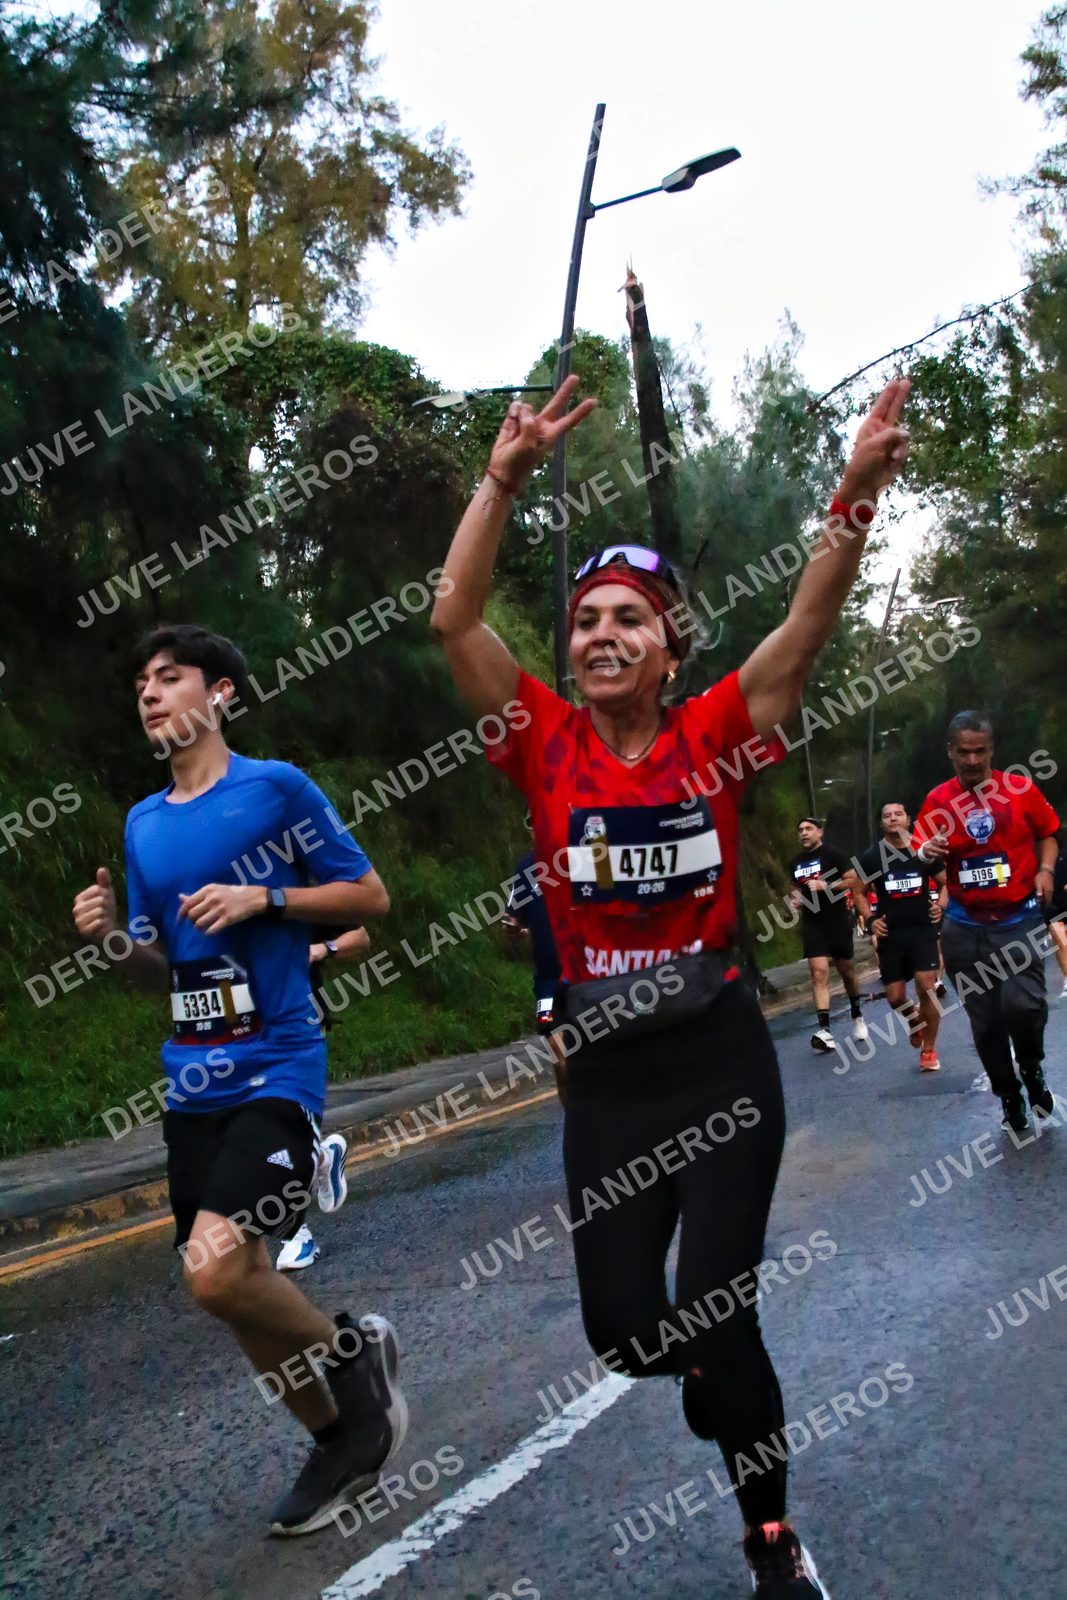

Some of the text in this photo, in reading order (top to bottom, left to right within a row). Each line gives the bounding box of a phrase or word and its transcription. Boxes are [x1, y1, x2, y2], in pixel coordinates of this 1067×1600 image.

[619, 844, 678, 878] 4747
[971, 868, 994, 881] 5196
[584, 938, 703, 978] SANTIA
[183, 991, 221, 1019] 5334
